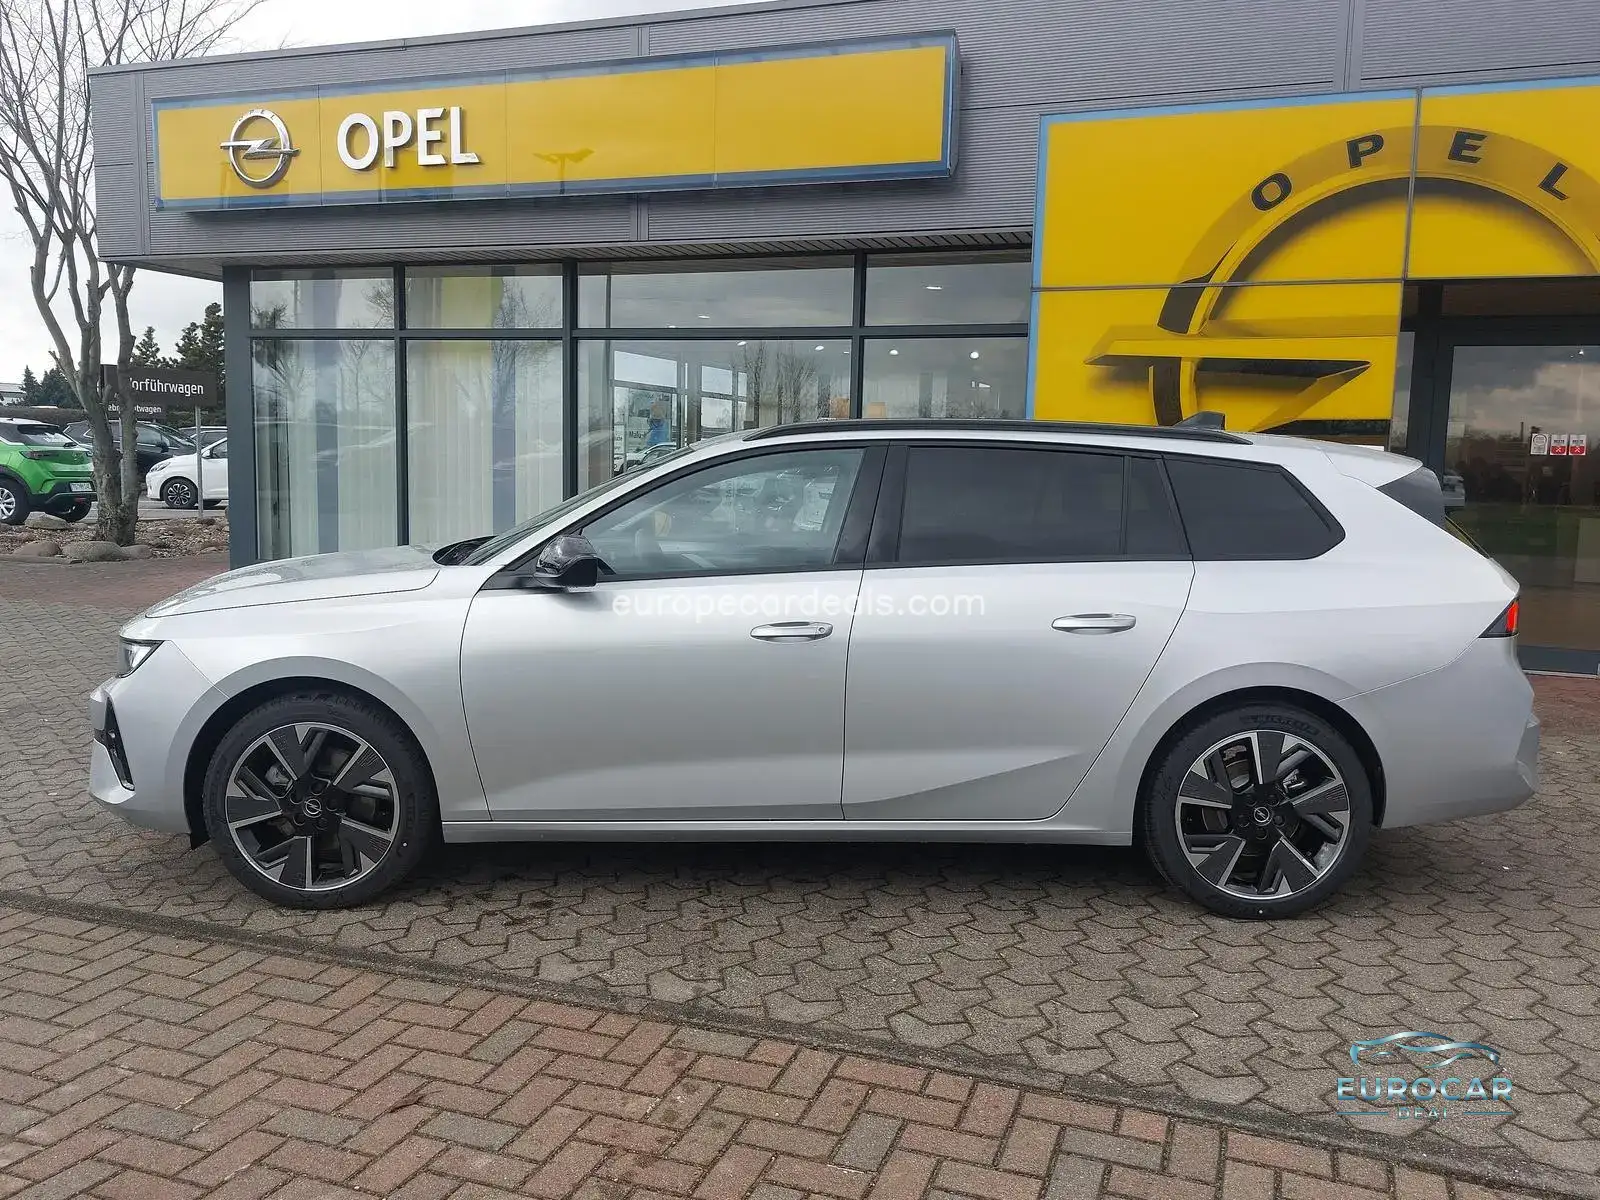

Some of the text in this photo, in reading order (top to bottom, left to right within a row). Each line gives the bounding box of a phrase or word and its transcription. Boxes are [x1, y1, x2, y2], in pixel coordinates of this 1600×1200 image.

[337, 106, 480, 170] OPEL
[1250, 130, 1570, 212] OPEL
[129, 377, 204, 397] orführwagen
